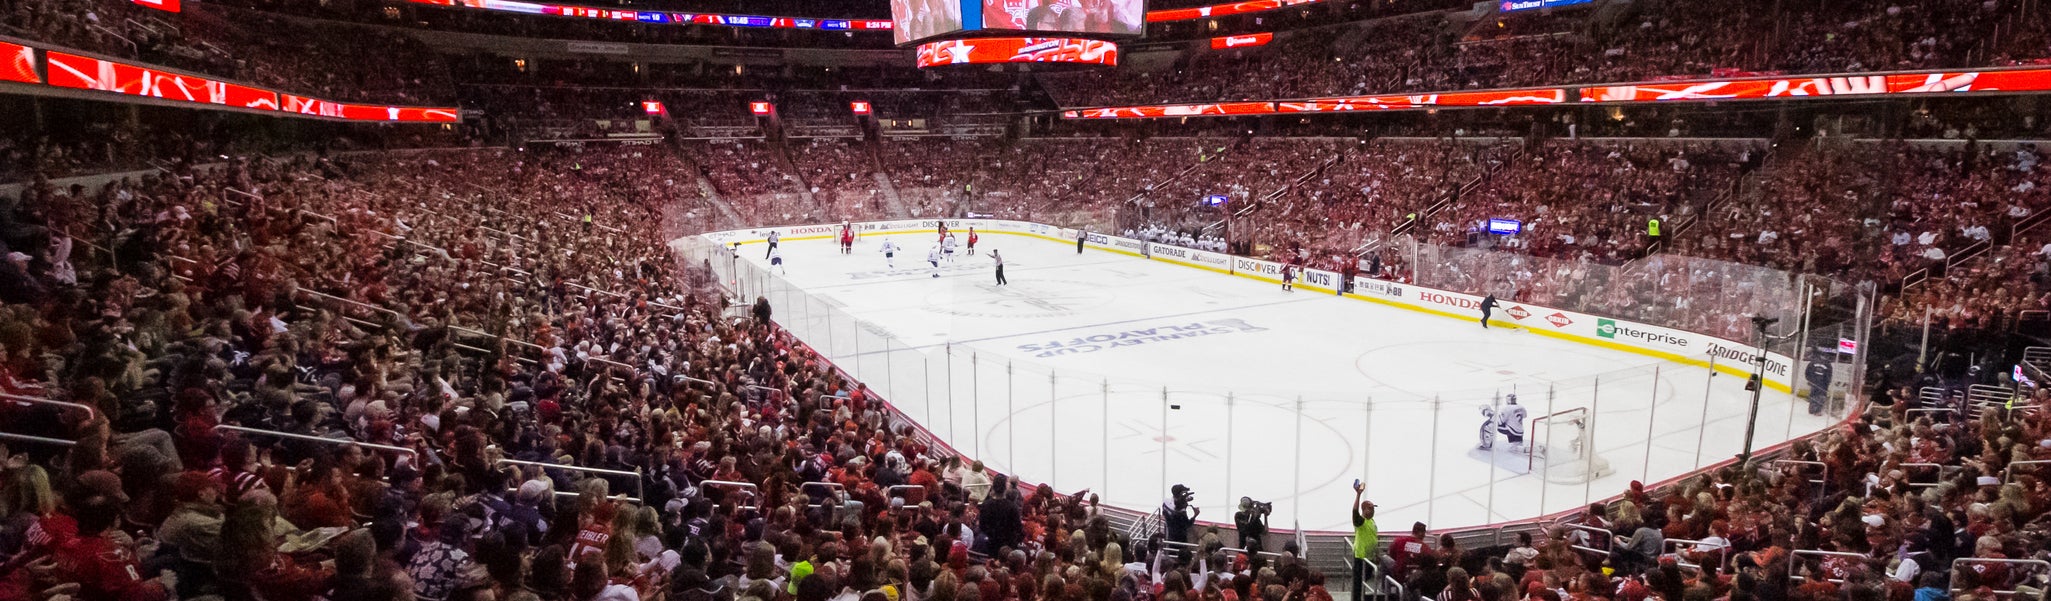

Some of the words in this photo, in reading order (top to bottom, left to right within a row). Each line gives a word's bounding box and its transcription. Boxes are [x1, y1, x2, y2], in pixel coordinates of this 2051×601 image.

[791, 226, 832, 235] HONDA
[922, 220, 960, 228] DISCVER
[1153, 245, 1186, 258] GATORADE
[1306, 271, 1331, 286] NUTS!
[1419, 291, 1482, 310] HONDA
[1507, 307, 1528, 318] ORKIN
[1547, 314, 1569, 325] ORKIN
[1016, 322, 1205, 352] PLAYOFFS
[1109, 326, 1235, 349] STANLEY
[1602, 323, 1688, 347] enterprise
[1034, 344, 1103, 358] CUP
[1705, 342, 1788, 376] BRIDGEONE
